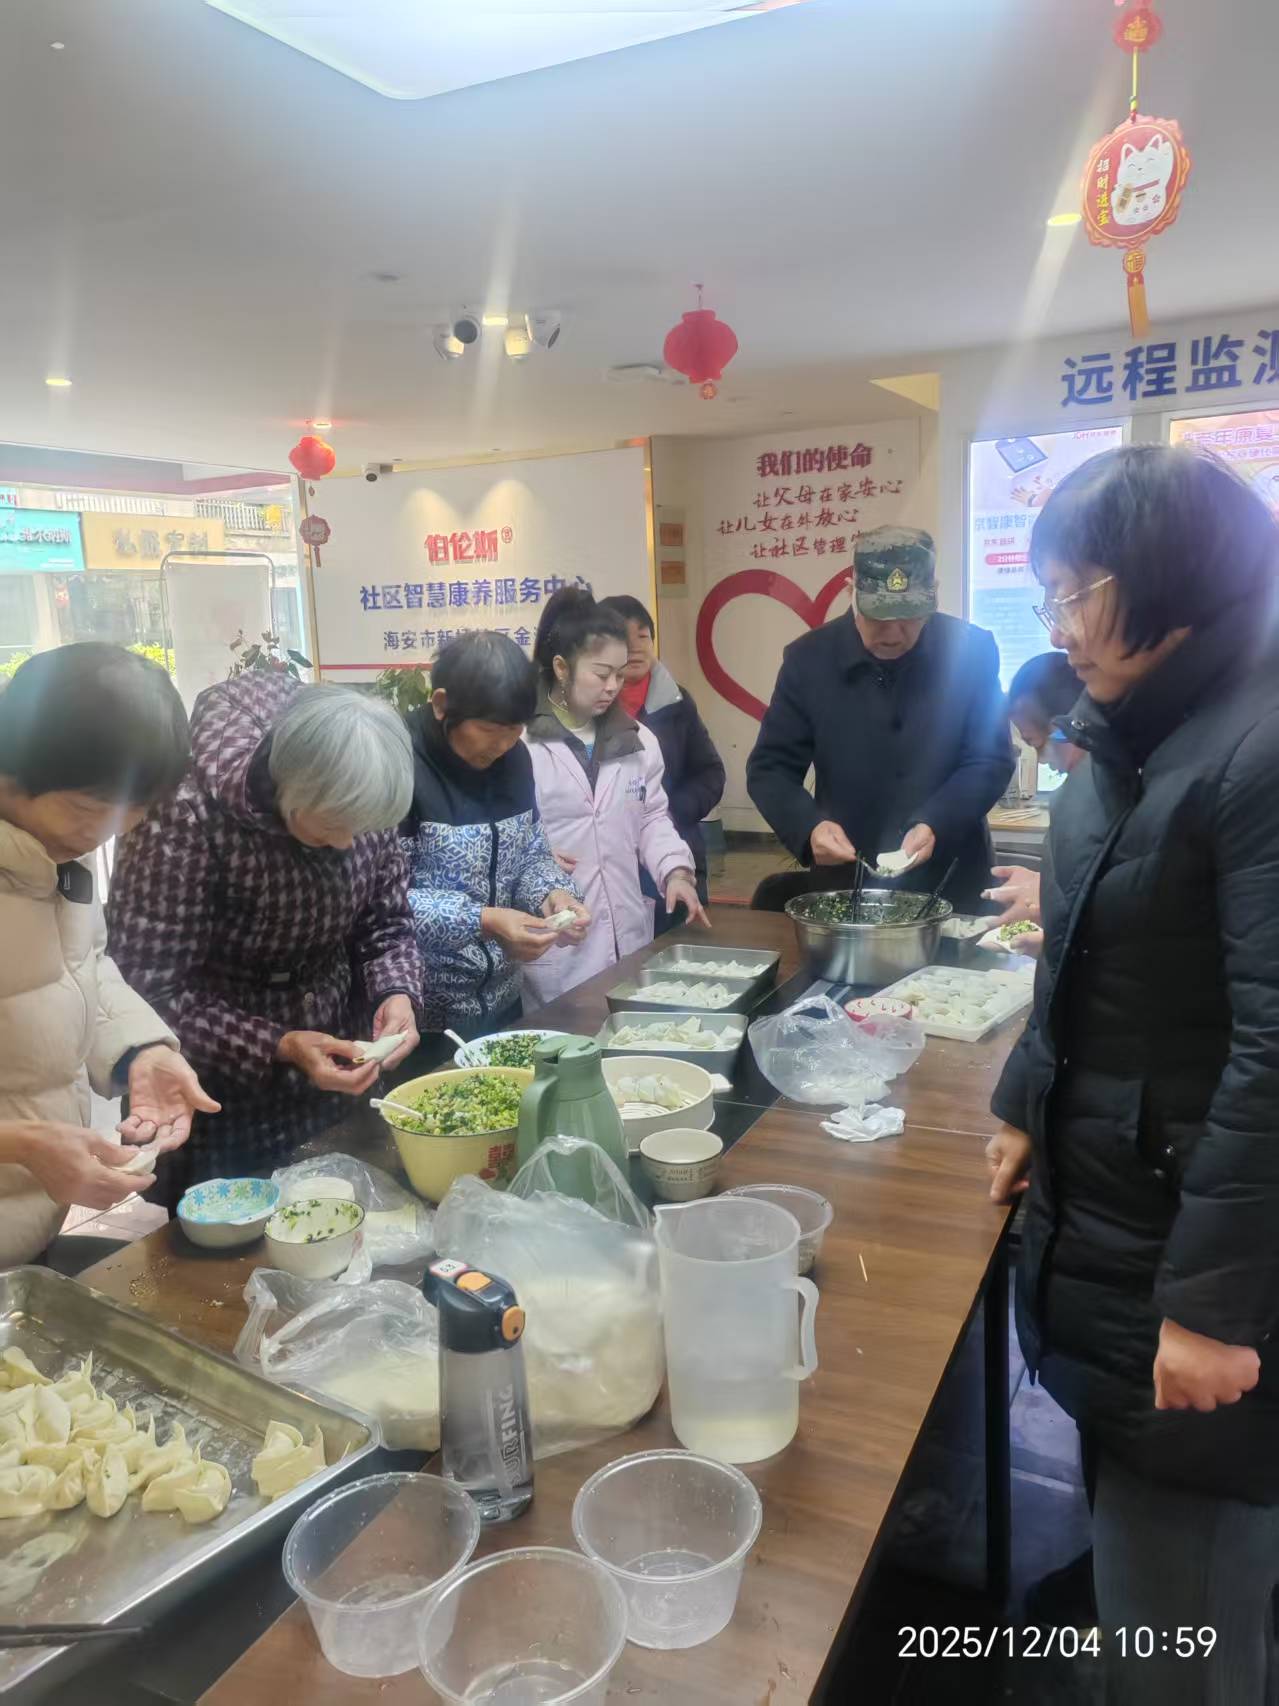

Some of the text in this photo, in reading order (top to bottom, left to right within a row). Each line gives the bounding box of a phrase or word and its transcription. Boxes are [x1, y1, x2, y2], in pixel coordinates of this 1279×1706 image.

[757, 442, 873, 478] 我们的使命
[753, 475, 903, 508] 让父母在家安心
[717, 508, 859, 536] 让儿女在外放心
[424, 528, 498, 566] 伯伦斯
